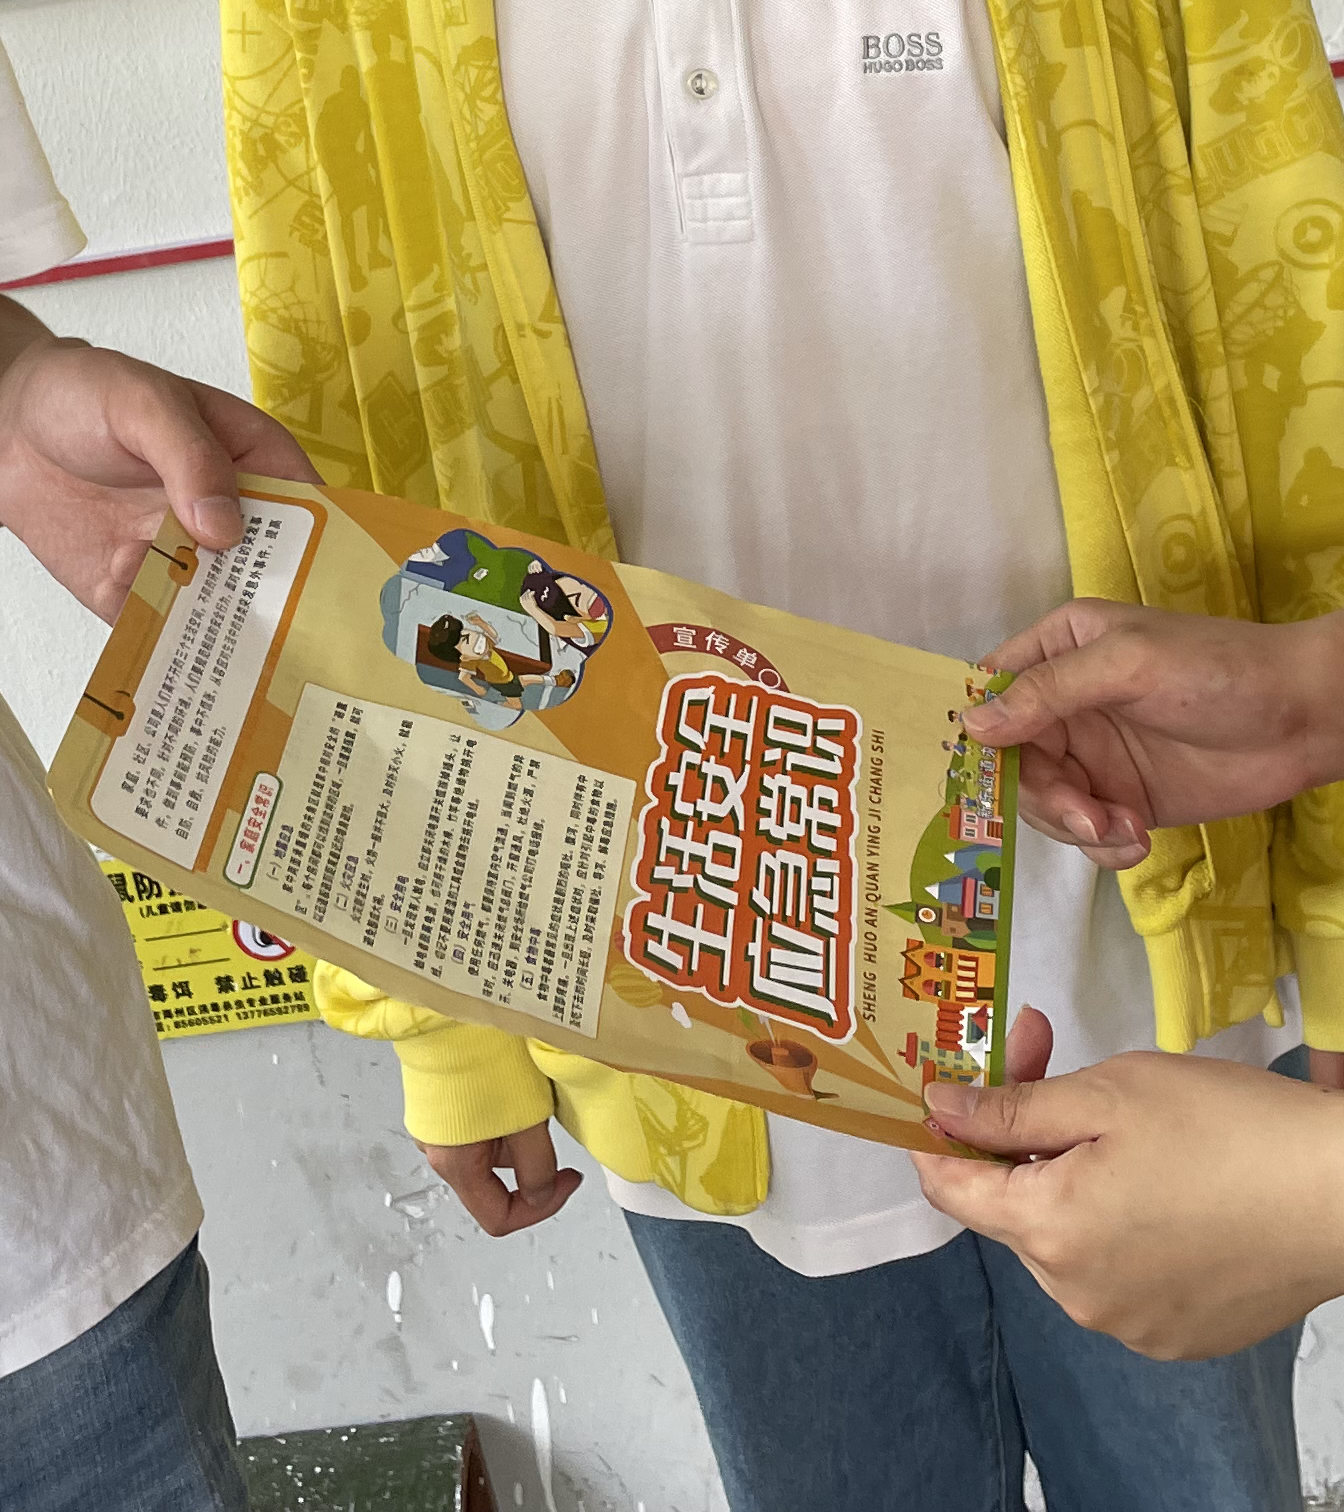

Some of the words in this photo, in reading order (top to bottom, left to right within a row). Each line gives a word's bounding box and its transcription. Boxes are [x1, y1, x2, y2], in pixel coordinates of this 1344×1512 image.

[861, 32, 943, 59] BOSS
[863, 60, 903, 73] HUGO
[905, 57, 944, 71] BOSS
[673, 626, 758, 669] 宣传单
[870, 728, 885, 753] SHI
[868, 756, 884, 805] CHANG
[867, 807, 882, 821] JI
[643, 684, 759, 986] 生活安全
[866, 823, 882, 858] YING
[747, 705, 845, 1022] 应急常识
[863, 861, 882, 904] QUAN
[863, 906, 878, 928] AN
[862, 930, 878, 963] HUO
[860, 970, 878, 1022] SHENG
